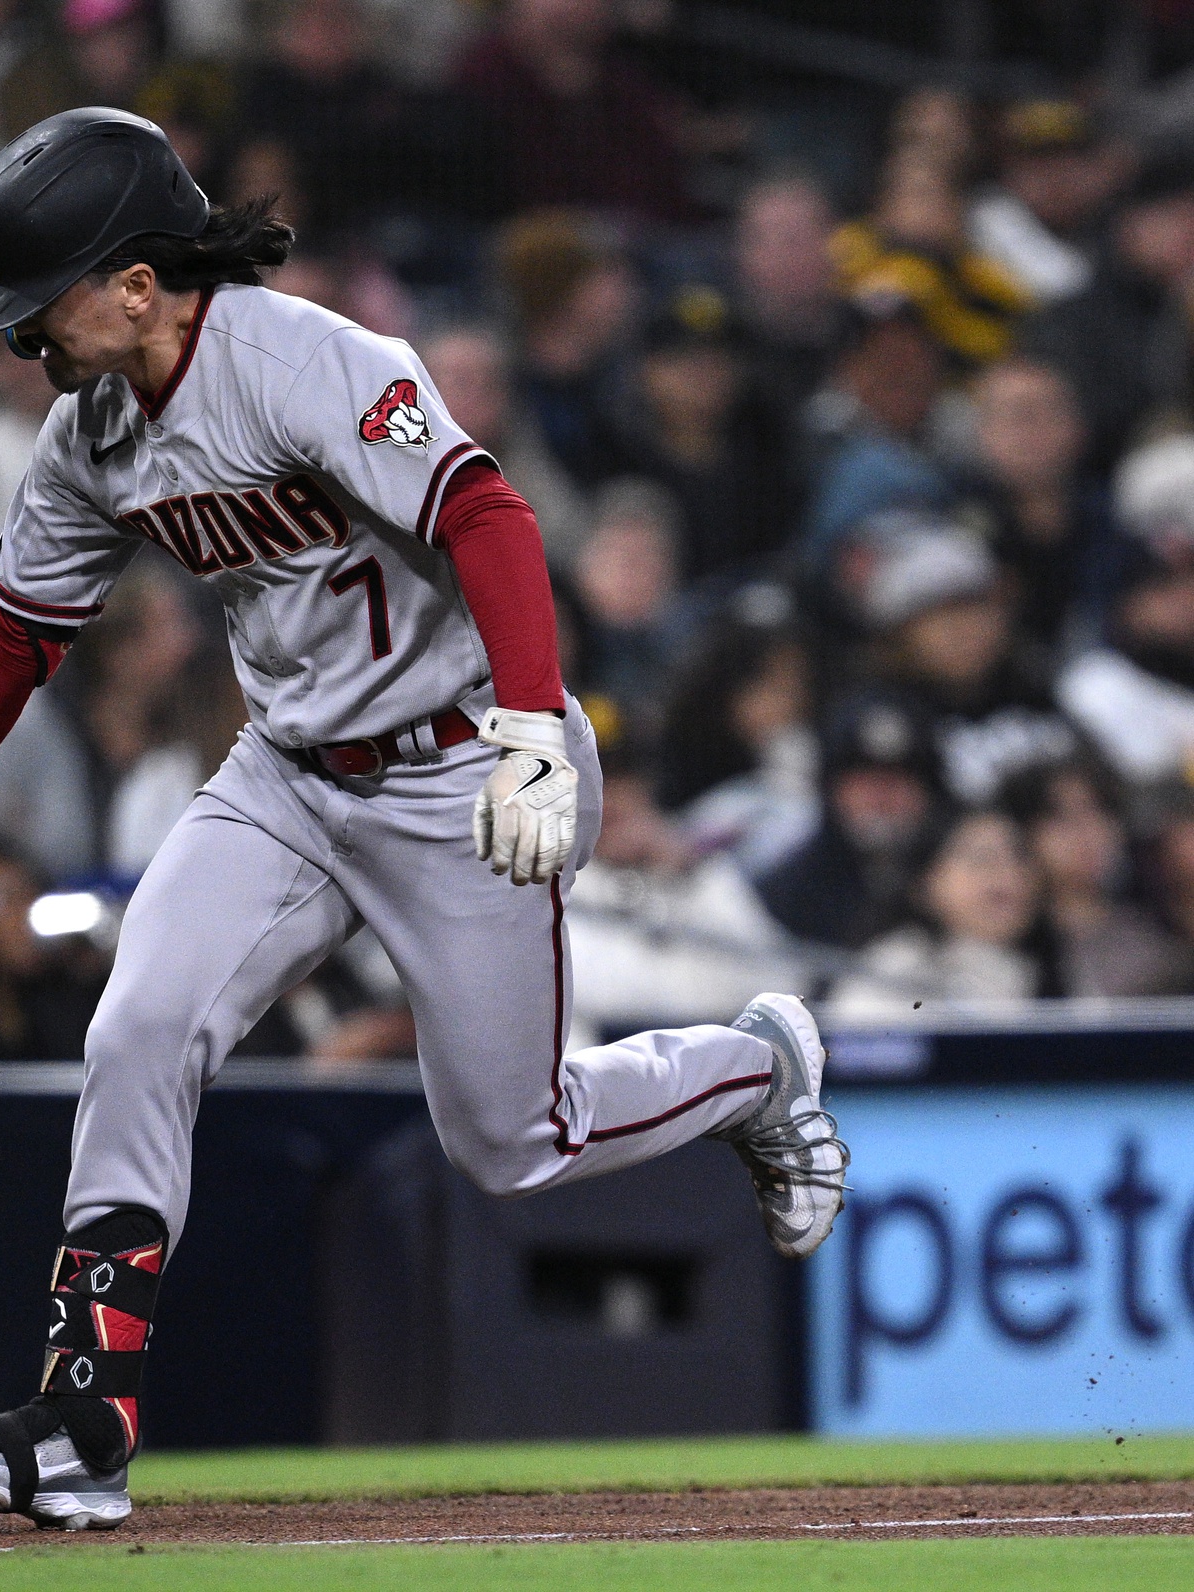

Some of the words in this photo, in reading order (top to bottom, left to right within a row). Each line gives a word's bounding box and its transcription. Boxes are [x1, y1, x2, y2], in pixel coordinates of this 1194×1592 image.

[114, 471, 352, 578] RIZONA
[327, 554, 392, 662] 7
[842, 1130, 1194, 1414] pet
